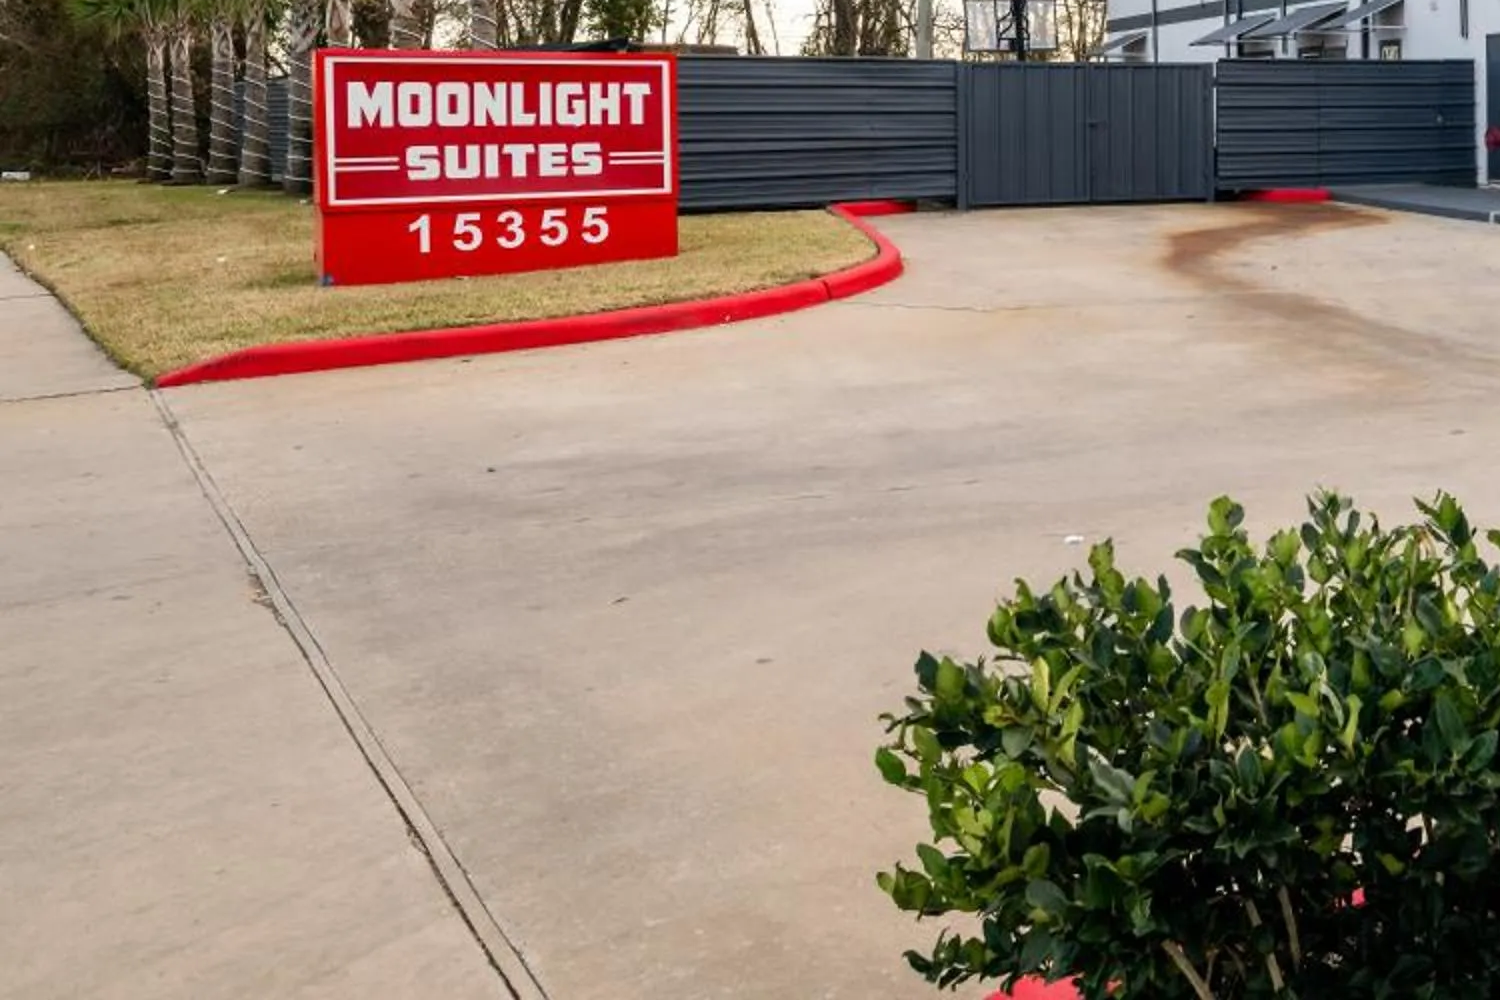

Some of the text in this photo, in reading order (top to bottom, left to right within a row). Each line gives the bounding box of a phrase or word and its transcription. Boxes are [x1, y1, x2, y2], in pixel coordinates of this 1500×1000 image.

[346, 81, 652, 129] MOONLIGHT
[405, 142, 603, 182] SUITES
[408, 206, 610, 254] 15355
